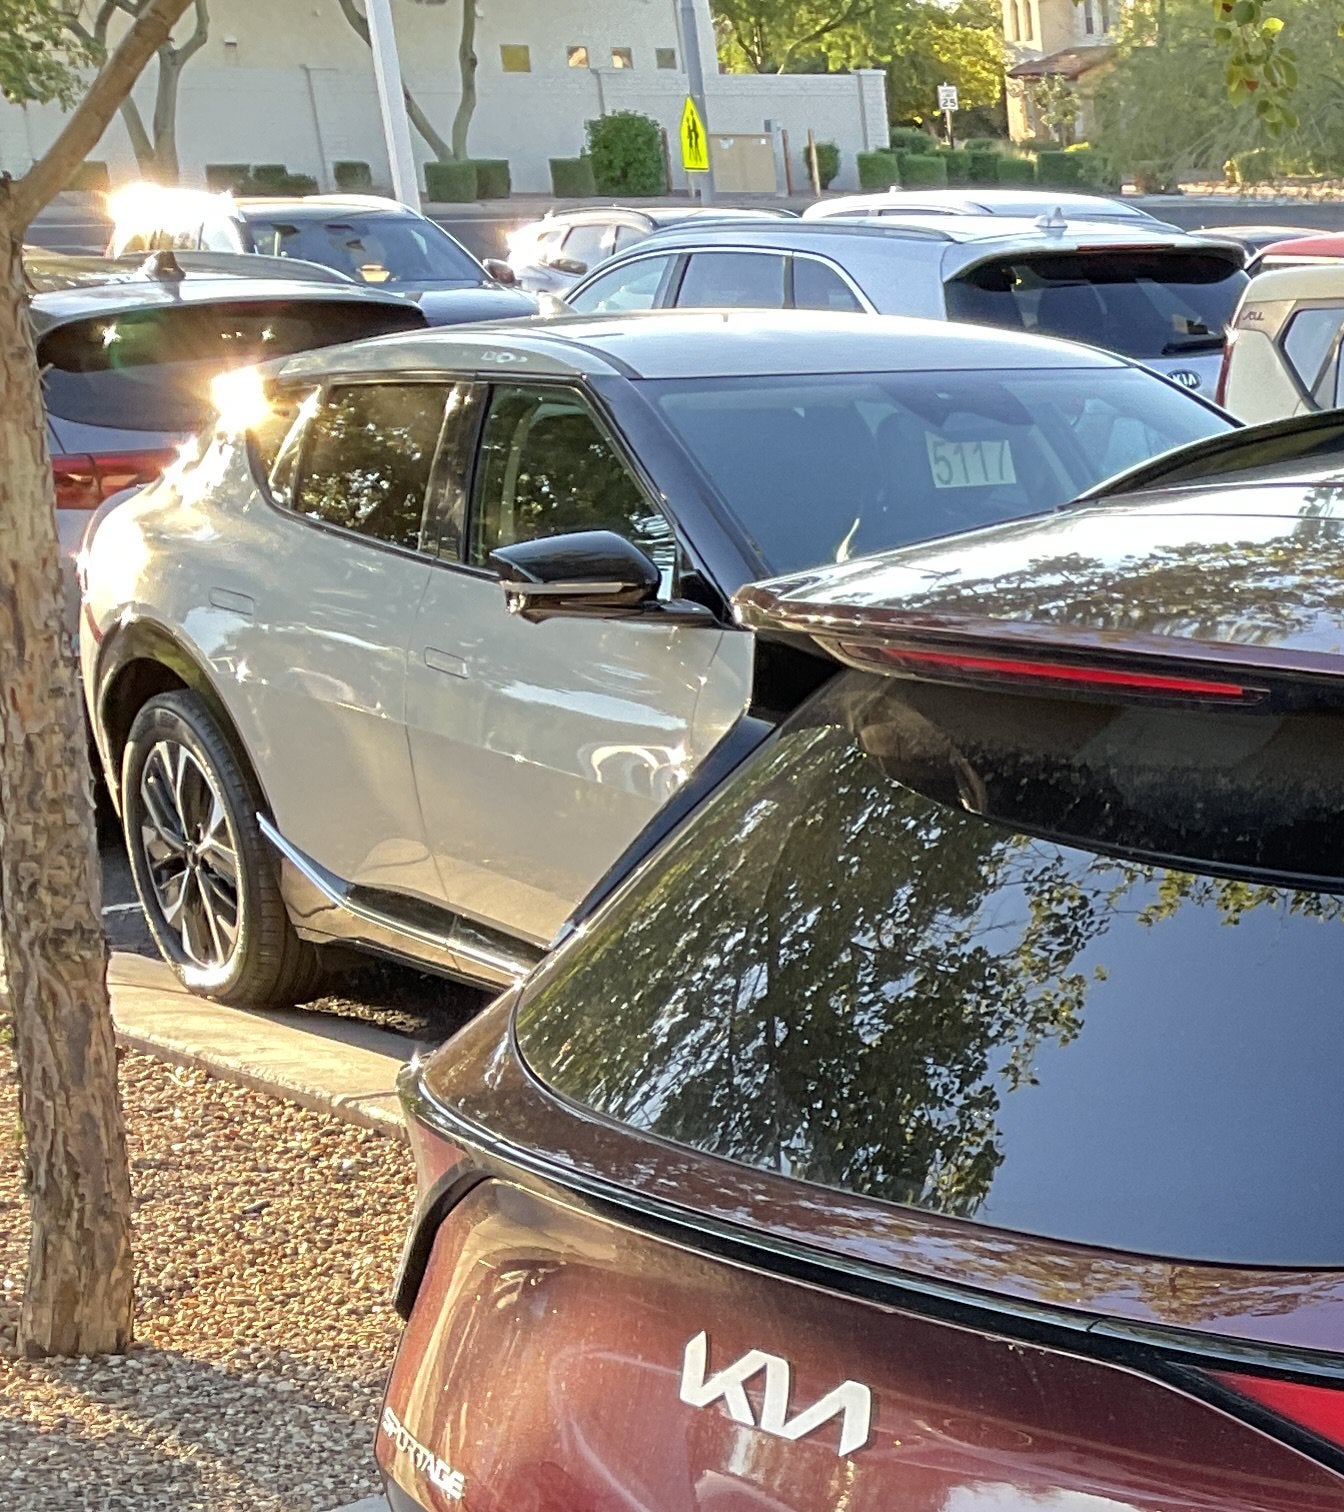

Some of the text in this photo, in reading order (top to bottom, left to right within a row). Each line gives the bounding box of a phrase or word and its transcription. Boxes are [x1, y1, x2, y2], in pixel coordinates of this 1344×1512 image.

[942, 98, 957, 108] 25
[1171, 373, 1197, 386] KIA
[679, 1330, 872, 1458] KIA
[382, 1407, 465, 1500] SPORTAGE
